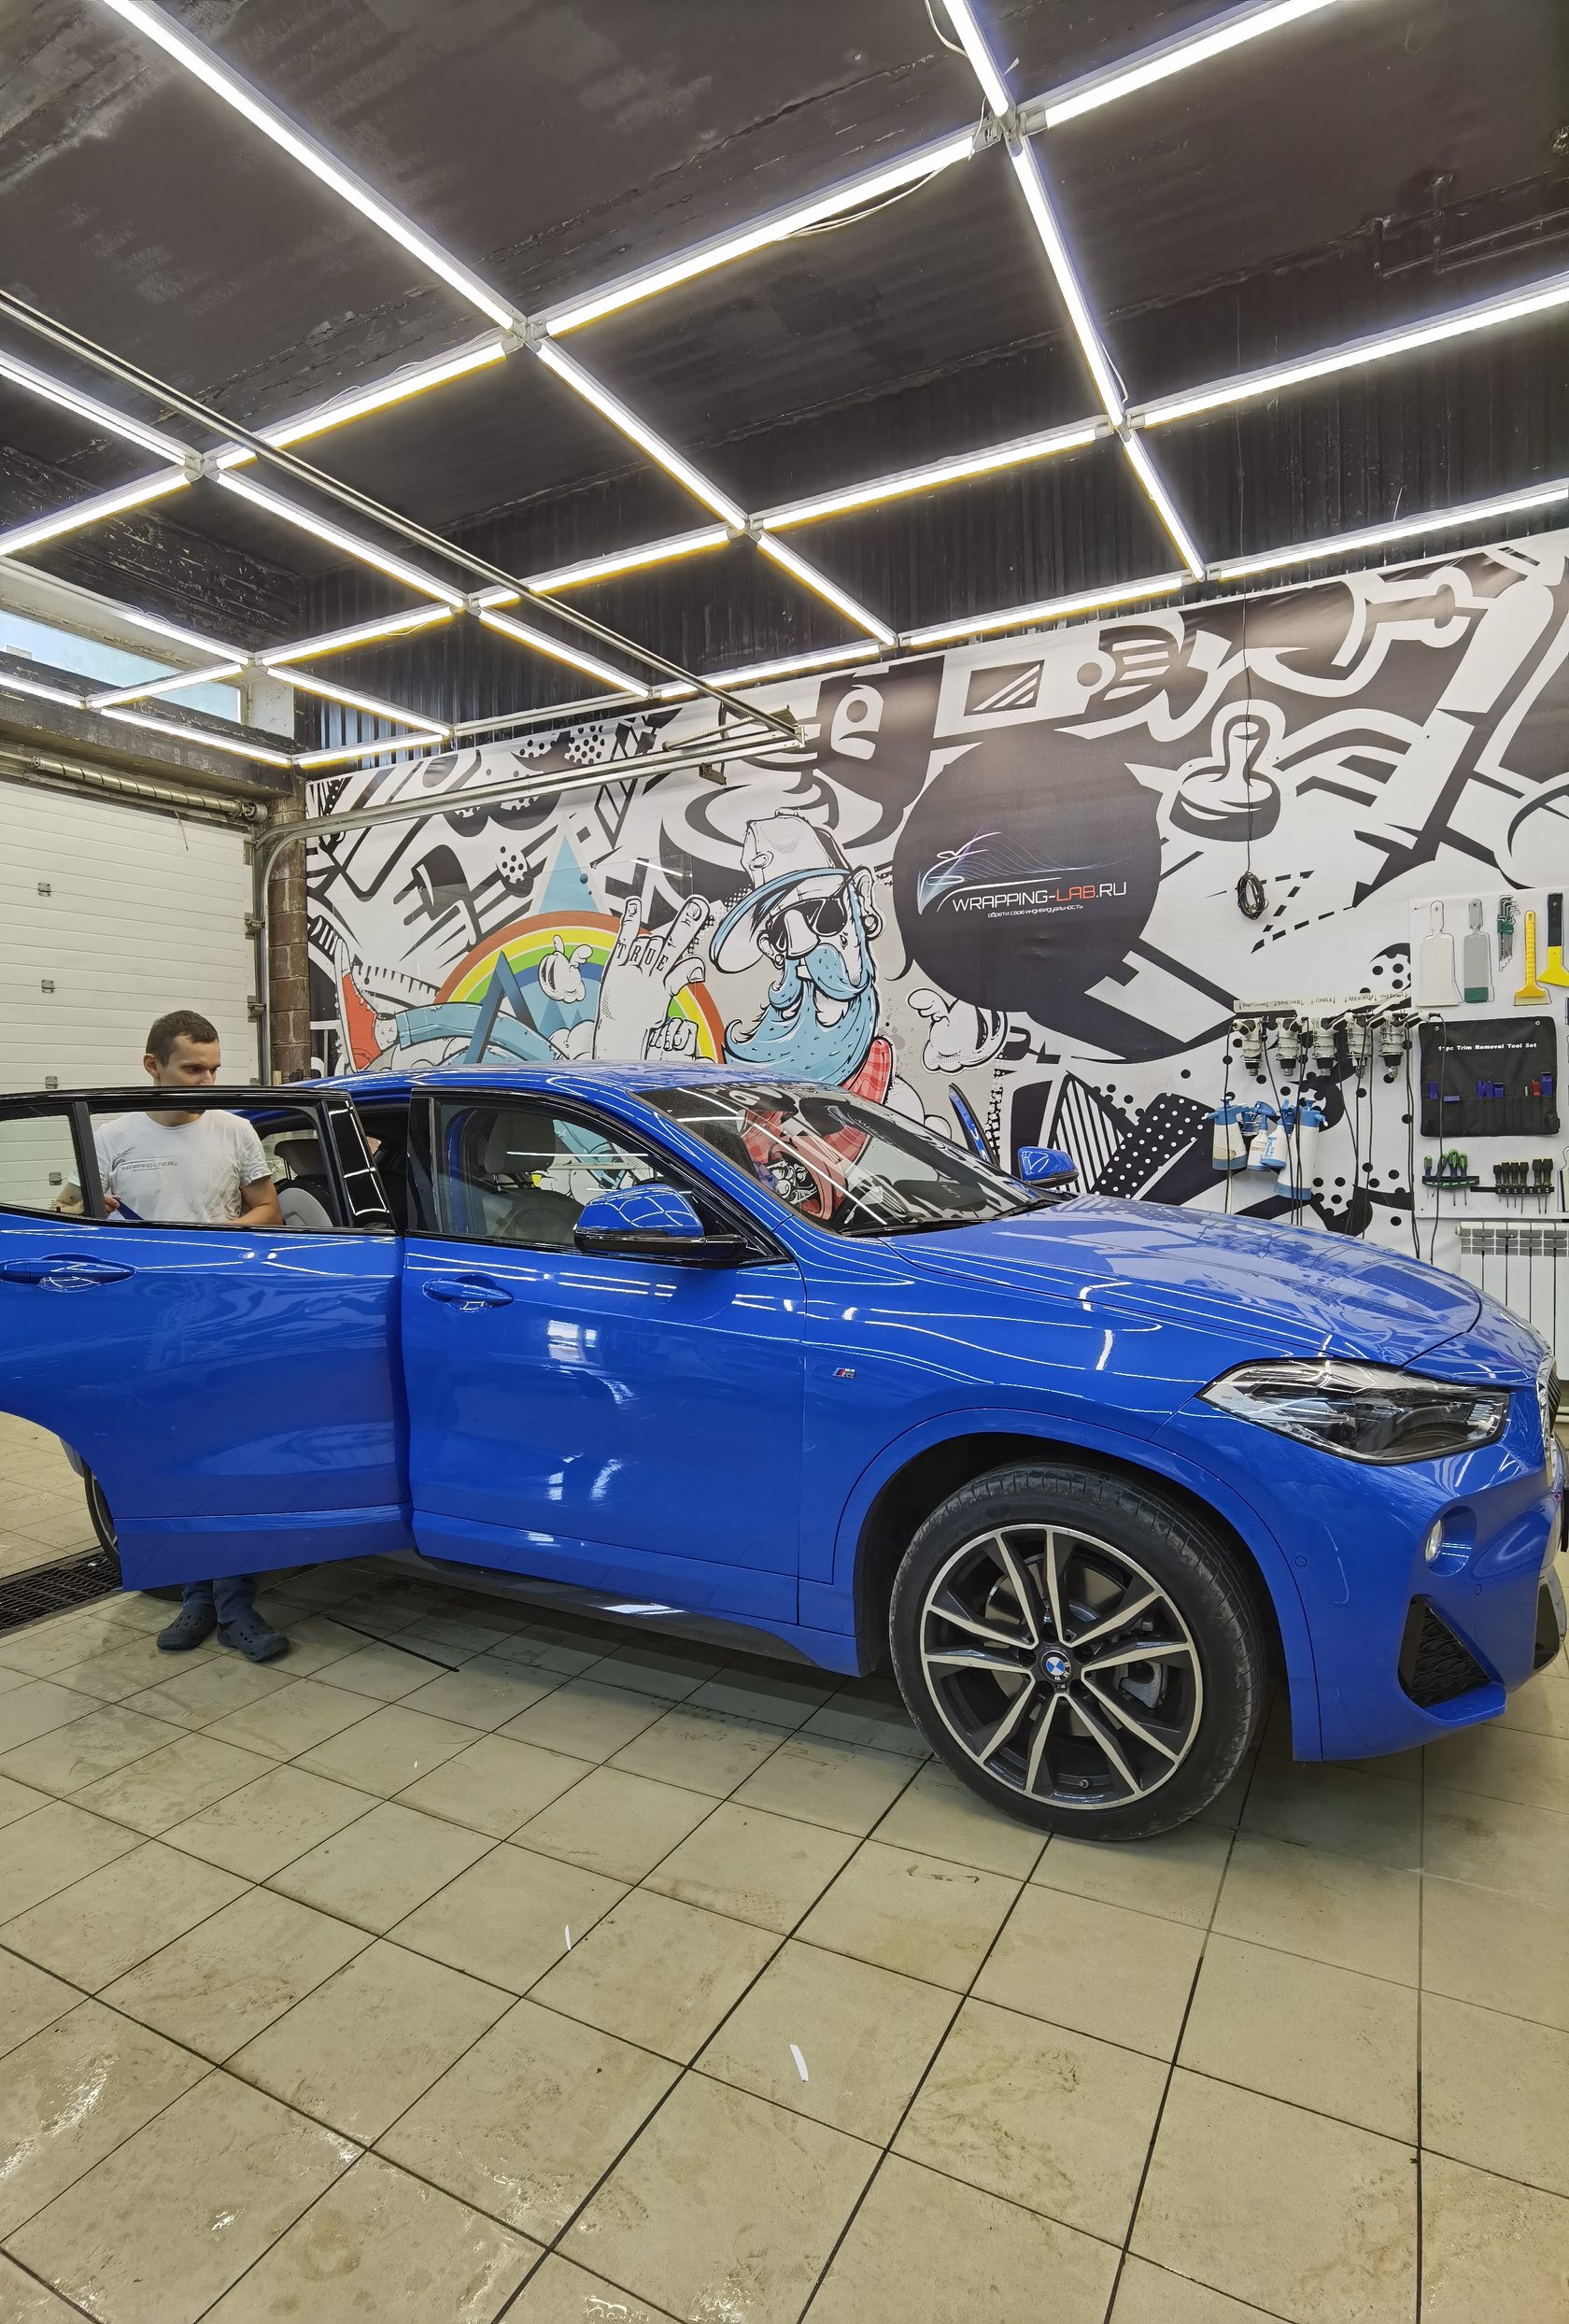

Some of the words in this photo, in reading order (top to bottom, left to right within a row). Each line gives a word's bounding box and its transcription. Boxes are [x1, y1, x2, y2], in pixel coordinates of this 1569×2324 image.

[953, 882, 1126, 912] WRAPPING-LAB.RU
[1025, 904, 1083, 915] индивидуальность
[617, 942, 669, 971] TRUE
